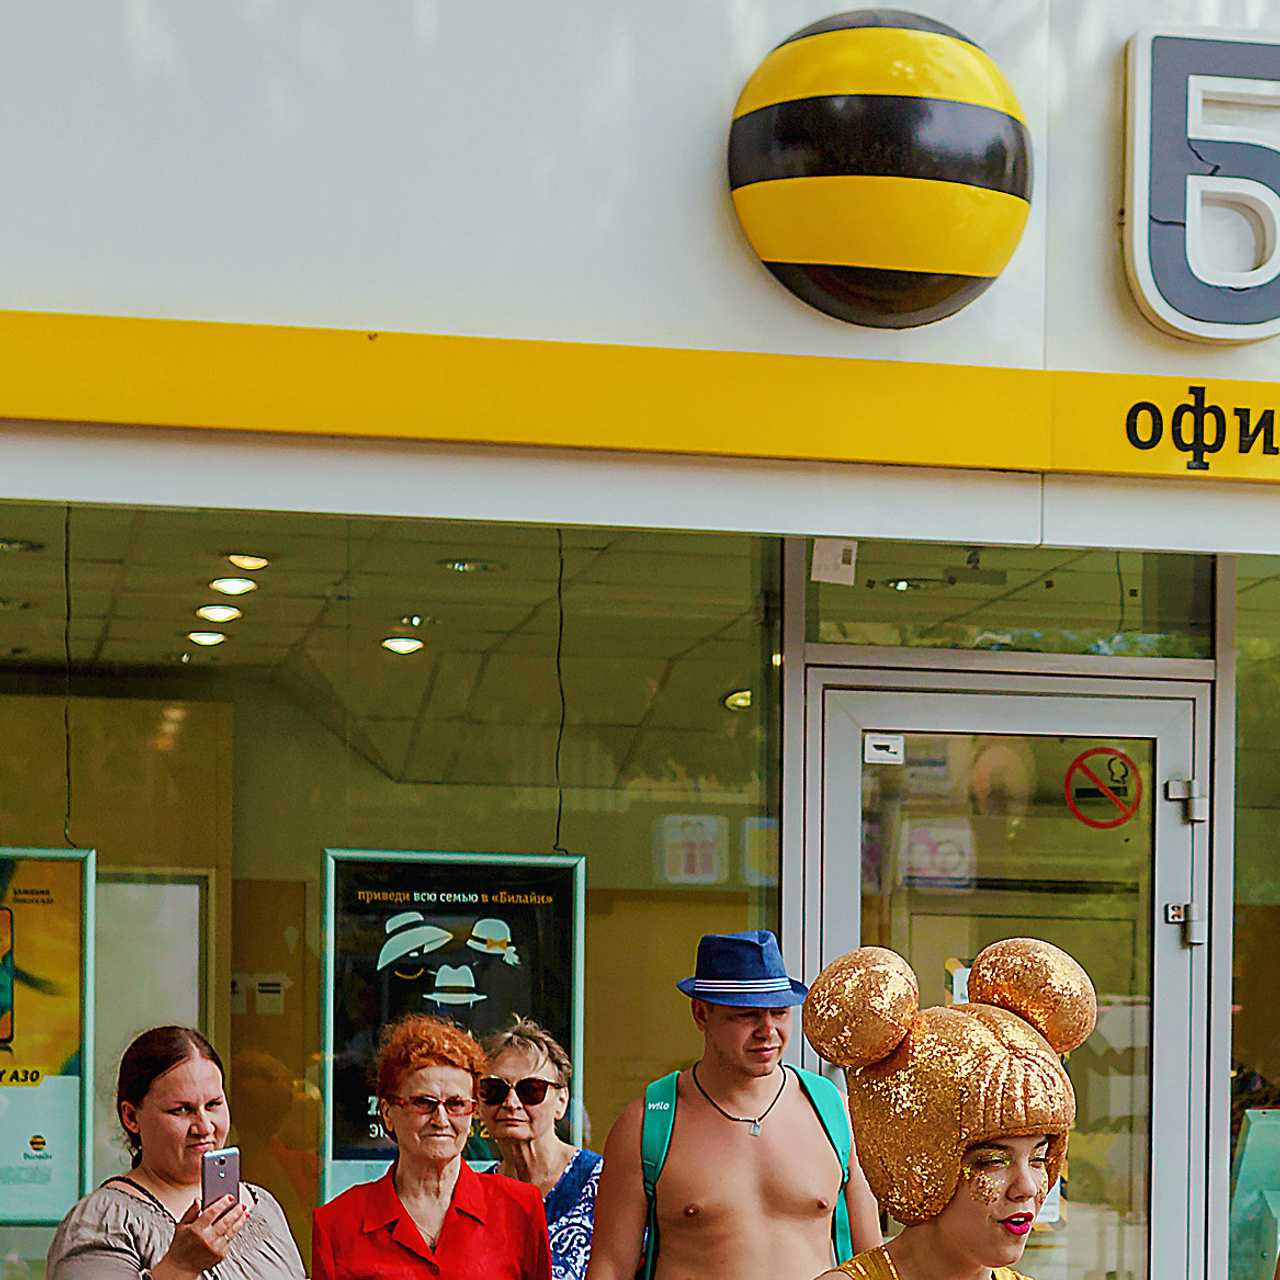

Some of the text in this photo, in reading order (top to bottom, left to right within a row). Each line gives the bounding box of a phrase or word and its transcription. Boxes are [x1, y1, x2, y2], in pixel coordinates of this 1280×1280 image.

[357, 890, 410, 904] приведи
[413, 891, 437, 903] всю
[439, 892, 479, 903] семью
[481, 893, 489, 903] в
[9, 1069, 40, 1083] A30
